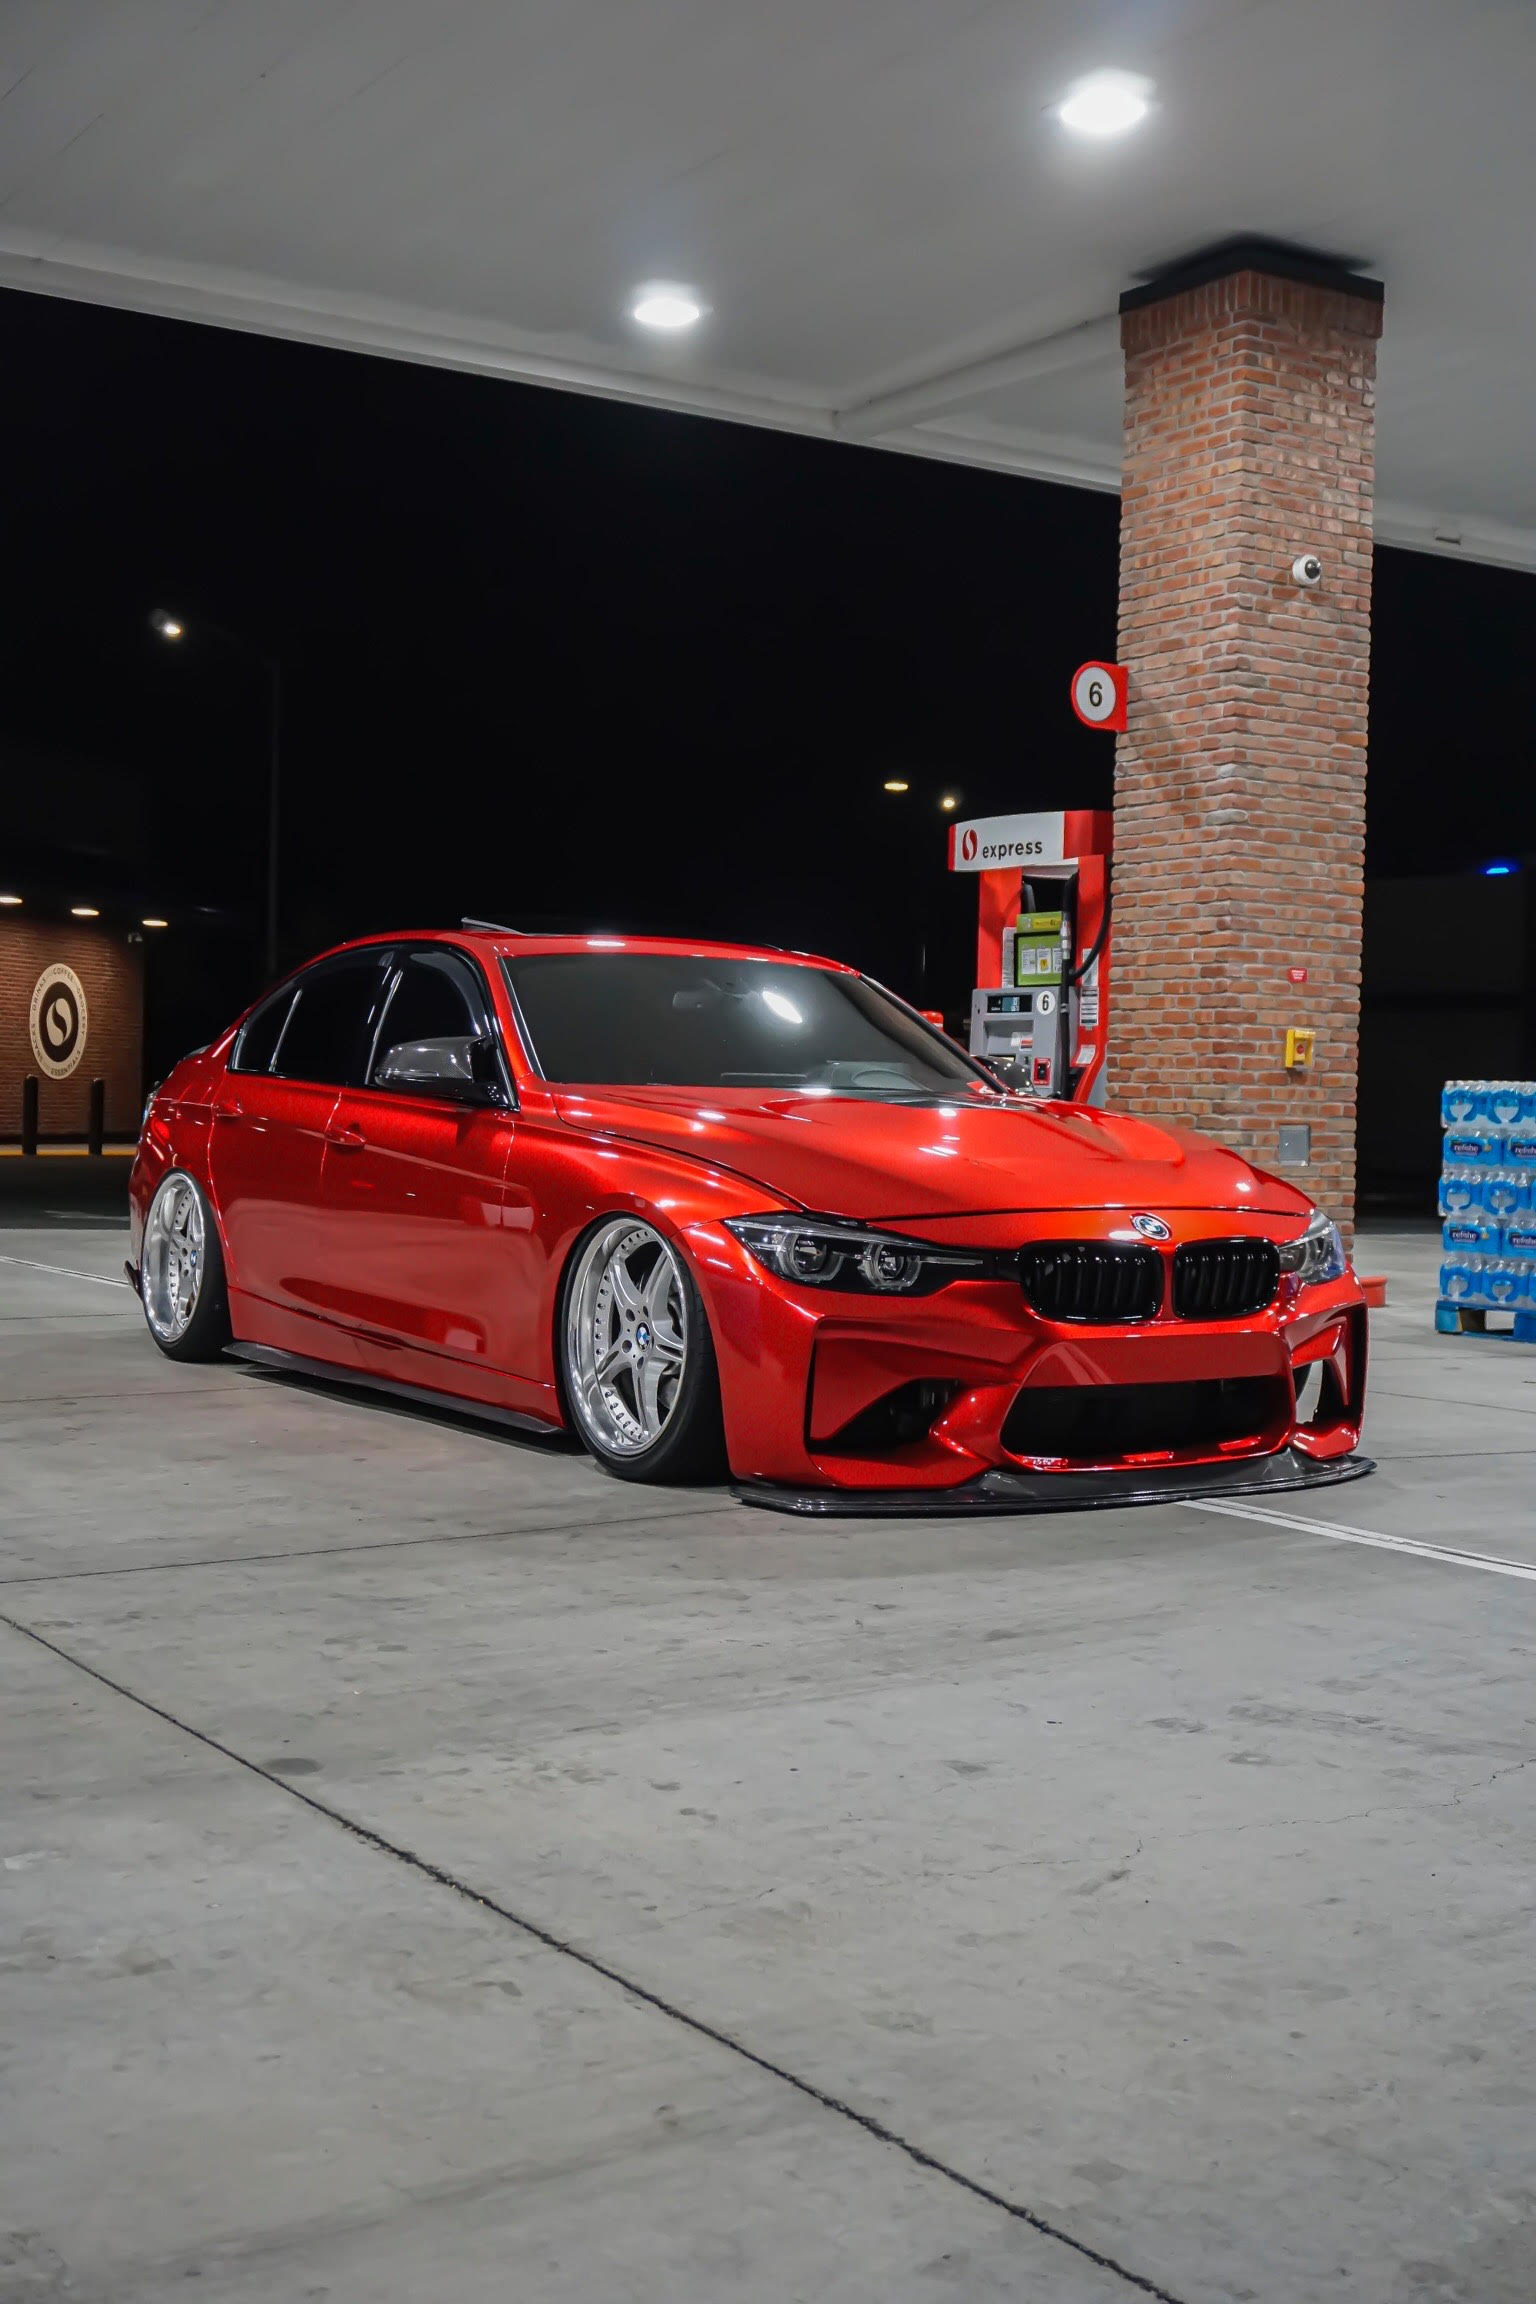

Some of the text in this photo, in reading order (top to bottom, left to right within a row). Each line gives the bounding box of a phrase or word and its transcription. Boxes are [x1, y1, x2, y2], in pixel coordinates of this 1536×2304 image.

[1089, 681, 1103, 707] 6
[982, 839, 1043, 861] express
[1042, 994, 1049, 1011] 6
